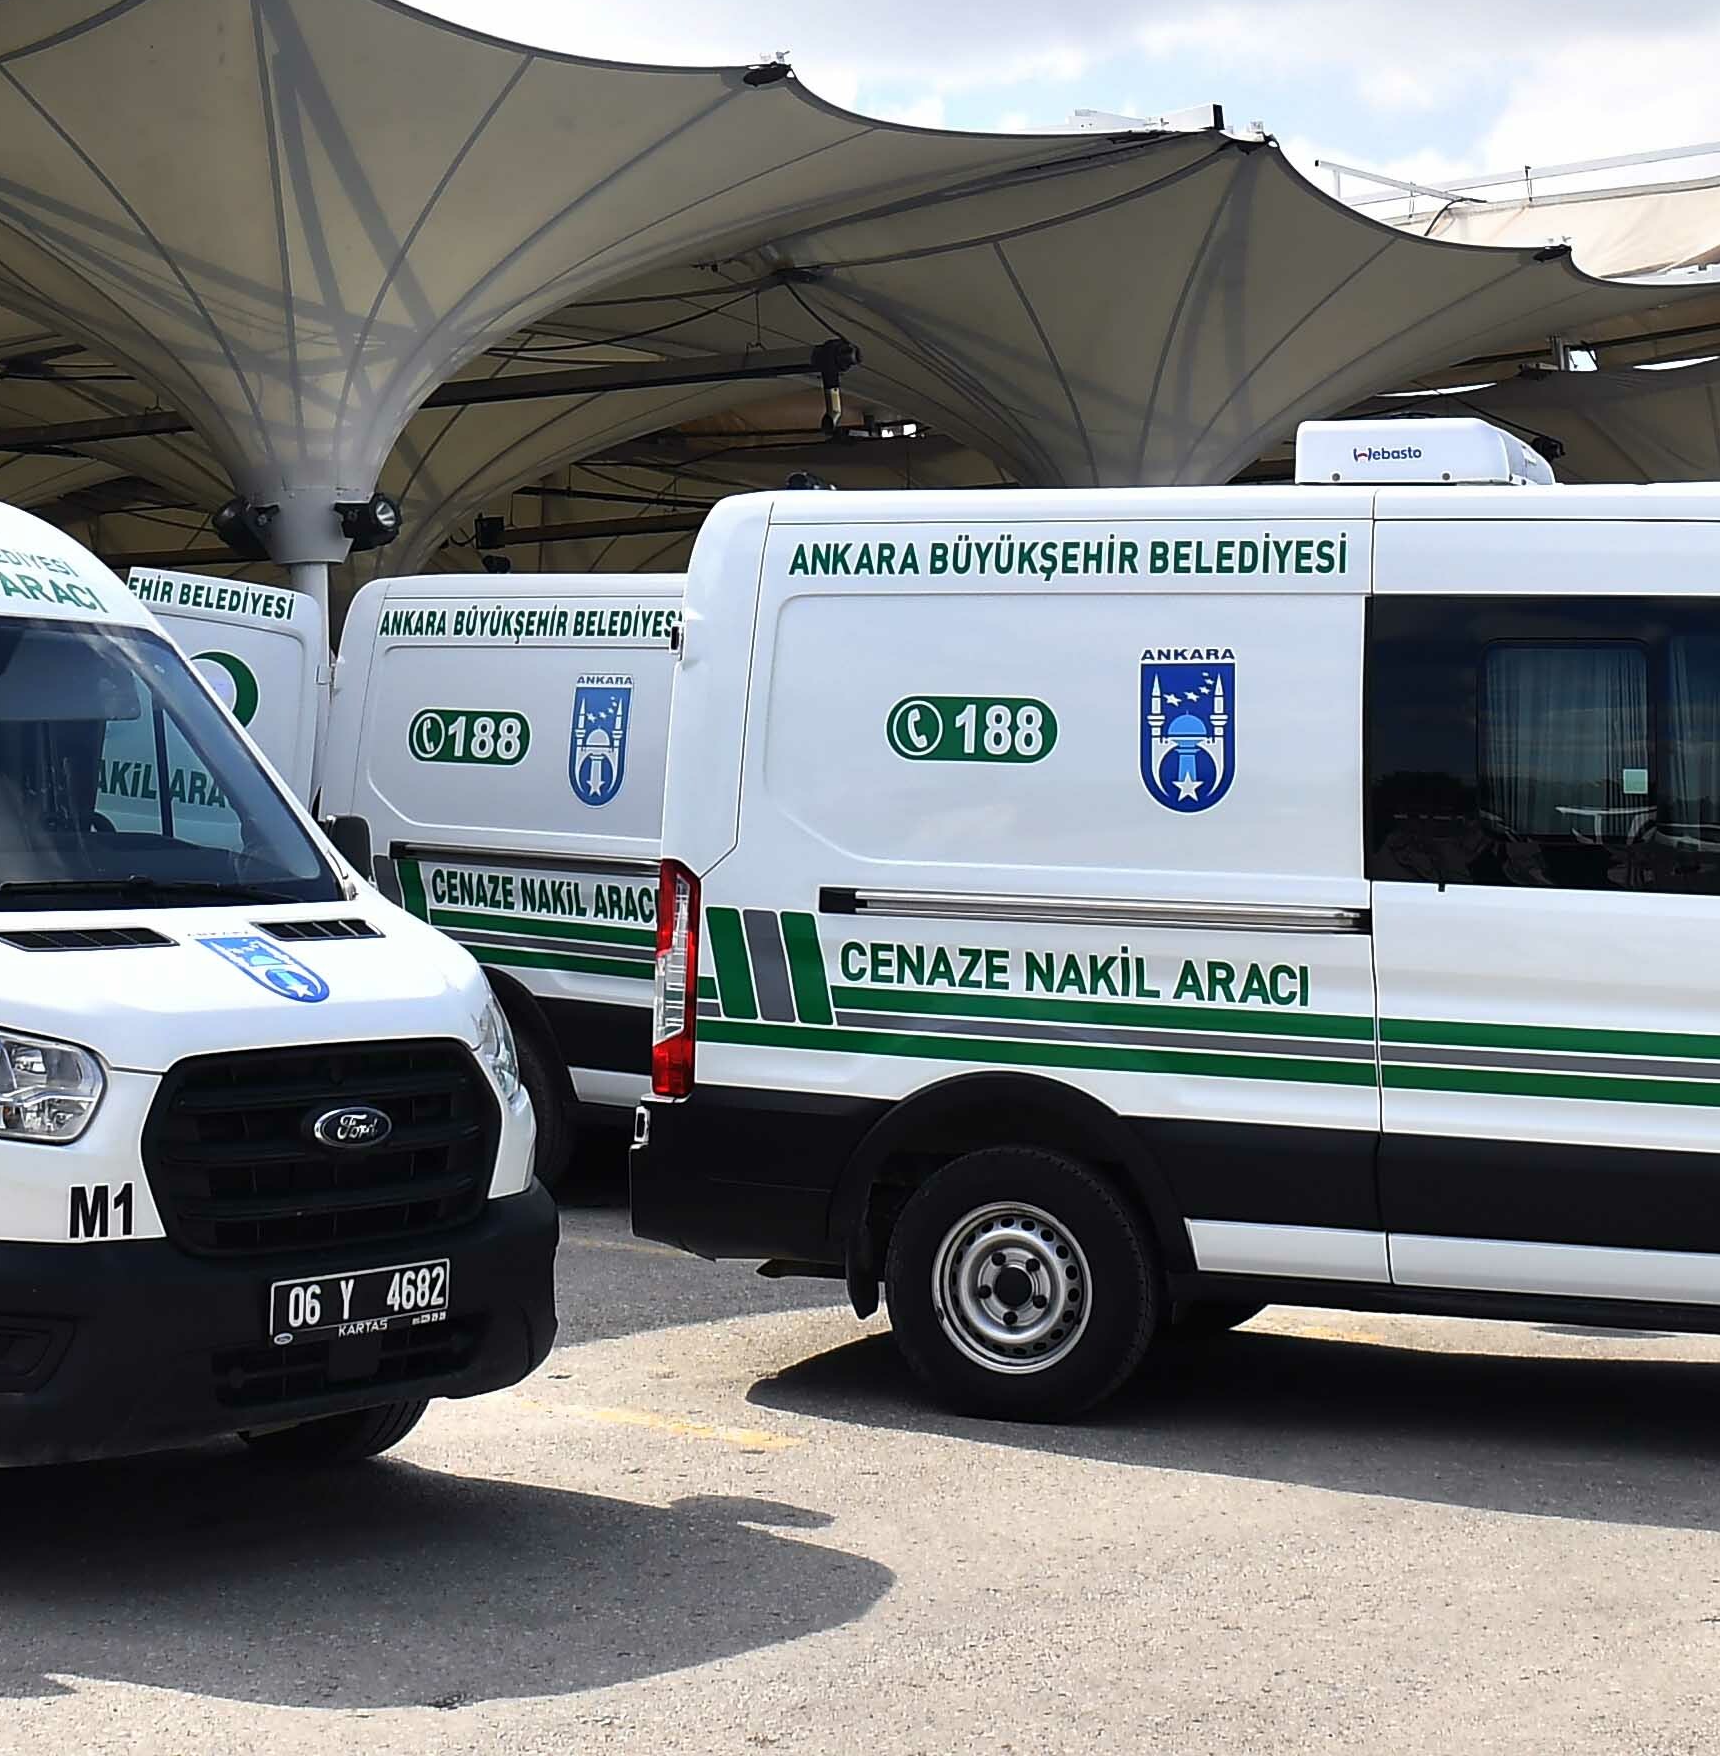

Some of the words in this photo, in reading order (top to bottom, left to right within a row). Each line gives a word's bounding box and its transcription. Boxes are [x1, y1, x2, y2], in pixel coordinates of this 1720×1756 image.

[1353, 446, 1422, 462] Webasto
[788, 542, 920, 576] ANKARA
[929, 534, 1139, 582] BÜYÜKŞEHİR
[1148, 532, 1347, 575] BELEDİYESİ
[2, 571, 109, 614] ARACI
[178, 583, 295, 620] BELEDİYESİ
[379, 610, 447, 637] ANKARA
[453, 605, 568, 644] BÜYÜKŞEHİR
[572, 604, 683, 638] BELEDİYES
[1140, 648, 1236, 662] ANKARA
[577, 675, 633, 686] ANKARA
[448, 716, 521, 760] 188
[954, 704, 1045, 756] 188
[169, 768, 226, 808] ARA
[431, 869, 515, 911] CENAZE
[840, 941, 1010, 992] CENAZE
[1024, 945, 1159, 1001] NAKİL
[1172, 960, 1310, 1007] ARACI
[336, 1113, 379, 1141] Ford
[68, 1181, 135, 1239] M1
[288, 1284, 322, 1327] 06
[339, 1278, 355, 1320] Y
[386, 1266, 445, 1312] 4682
